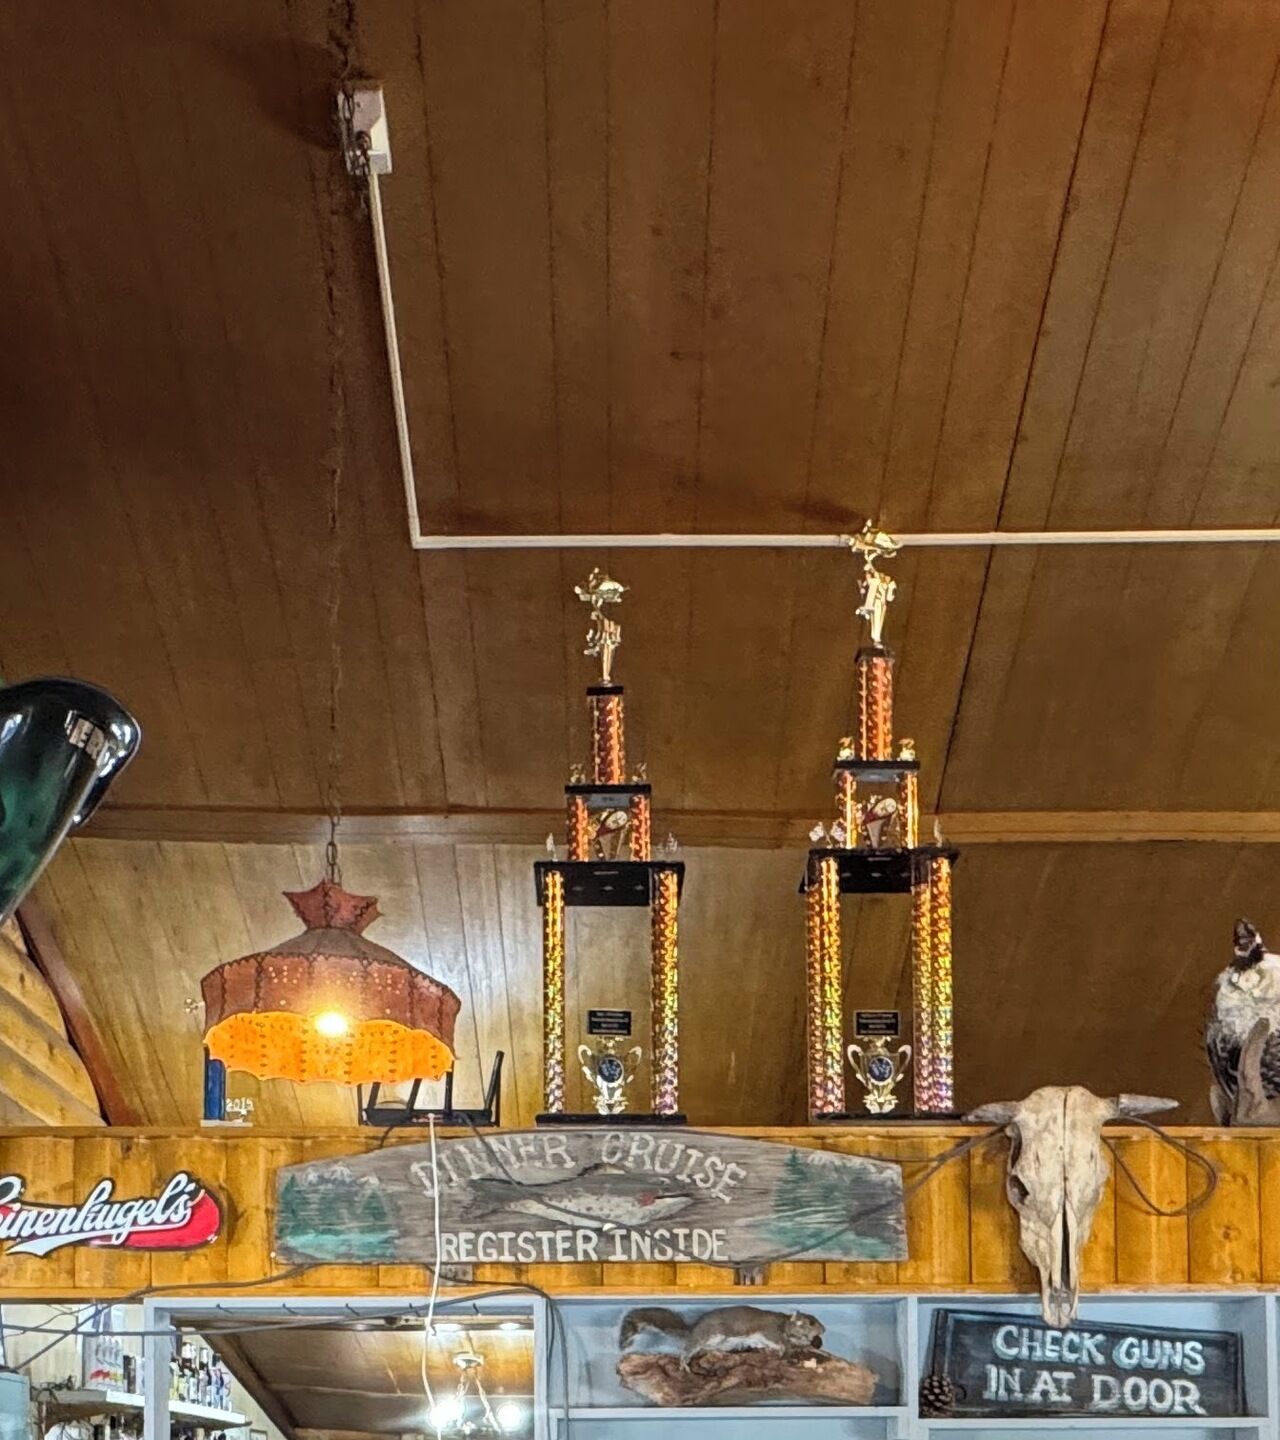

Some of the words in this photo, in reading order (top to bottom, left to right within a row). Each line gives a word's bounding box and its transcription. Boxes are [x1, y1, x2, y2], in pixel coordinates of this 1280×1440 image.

[410, 1133, 576, 1198] DINNER
[600, 1131, 747, 1205] CRUISE
[440, 1228, 599, 1262] REGISTER
[610, 1228, 729, 1262] INSIDE
[992, 1324, 1107, 1366] CHECK
[1112, 1336, 1206, 1375] GUNS
[983, 1364, 1023, 1402] IN
[1032, 1369, 1076, 1403] AT
[1091, 1373, 1208, 1416] DOOR
